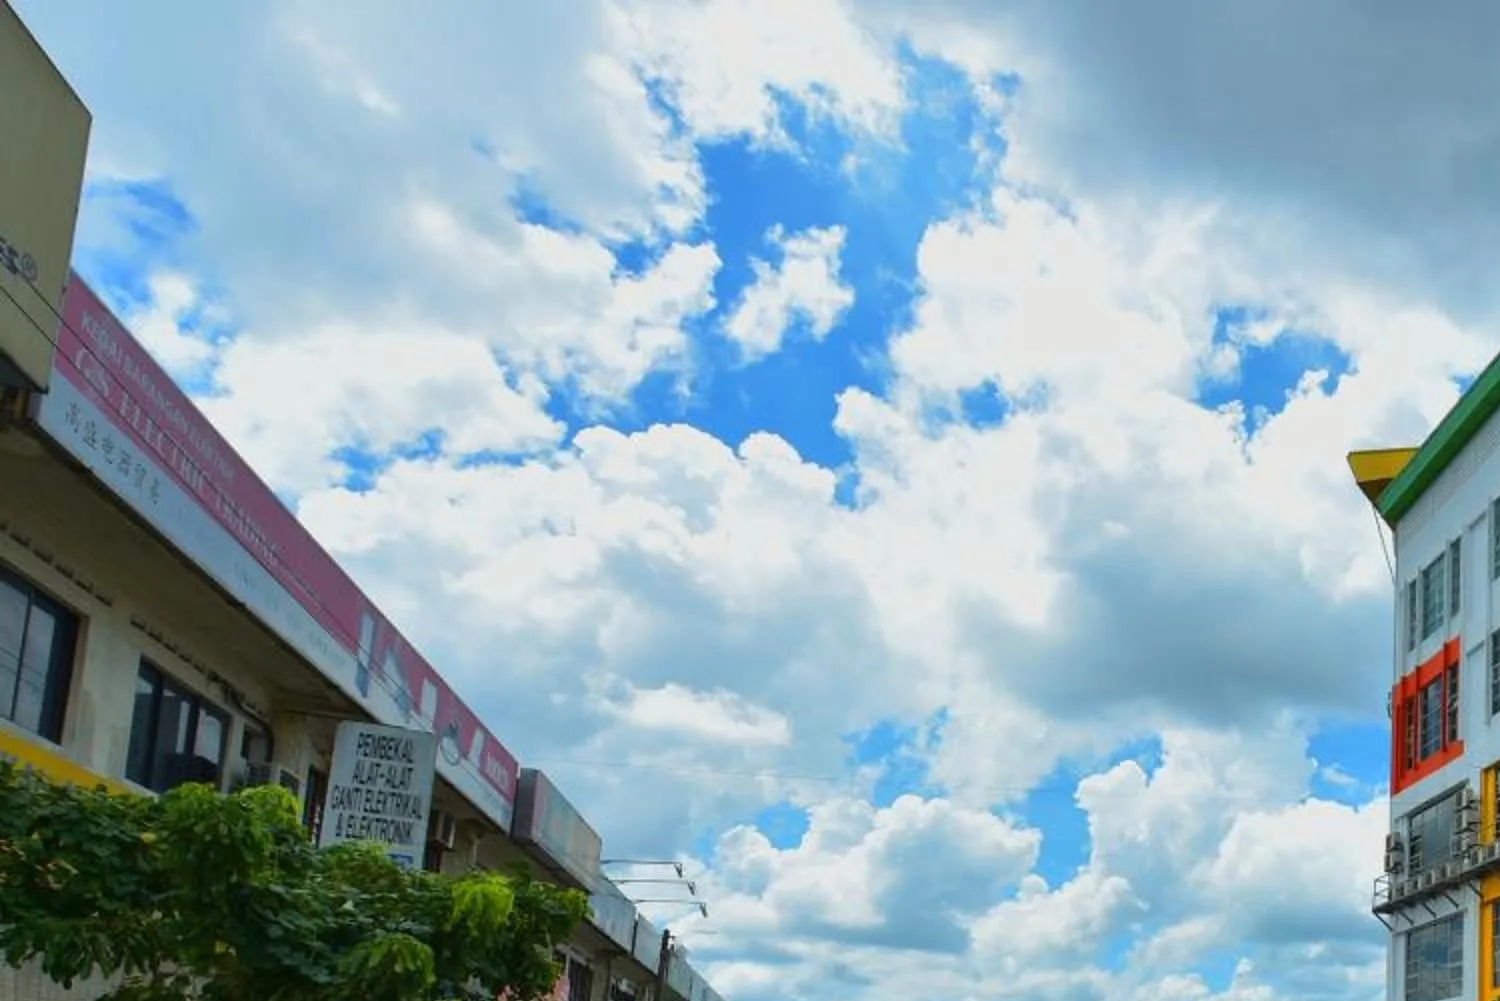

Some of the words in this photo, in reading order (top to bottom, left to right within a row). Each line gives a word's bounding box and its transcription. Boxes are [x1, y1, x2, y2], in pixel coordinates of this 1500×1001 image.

[356, 732, 414, 764] PEMBEKAL
[352, 760, 414, 790] ALAT-ALAT
[331, 784, 362, 811] GANTI
[364, 788, 422, 820] ELEKTRIKAL
